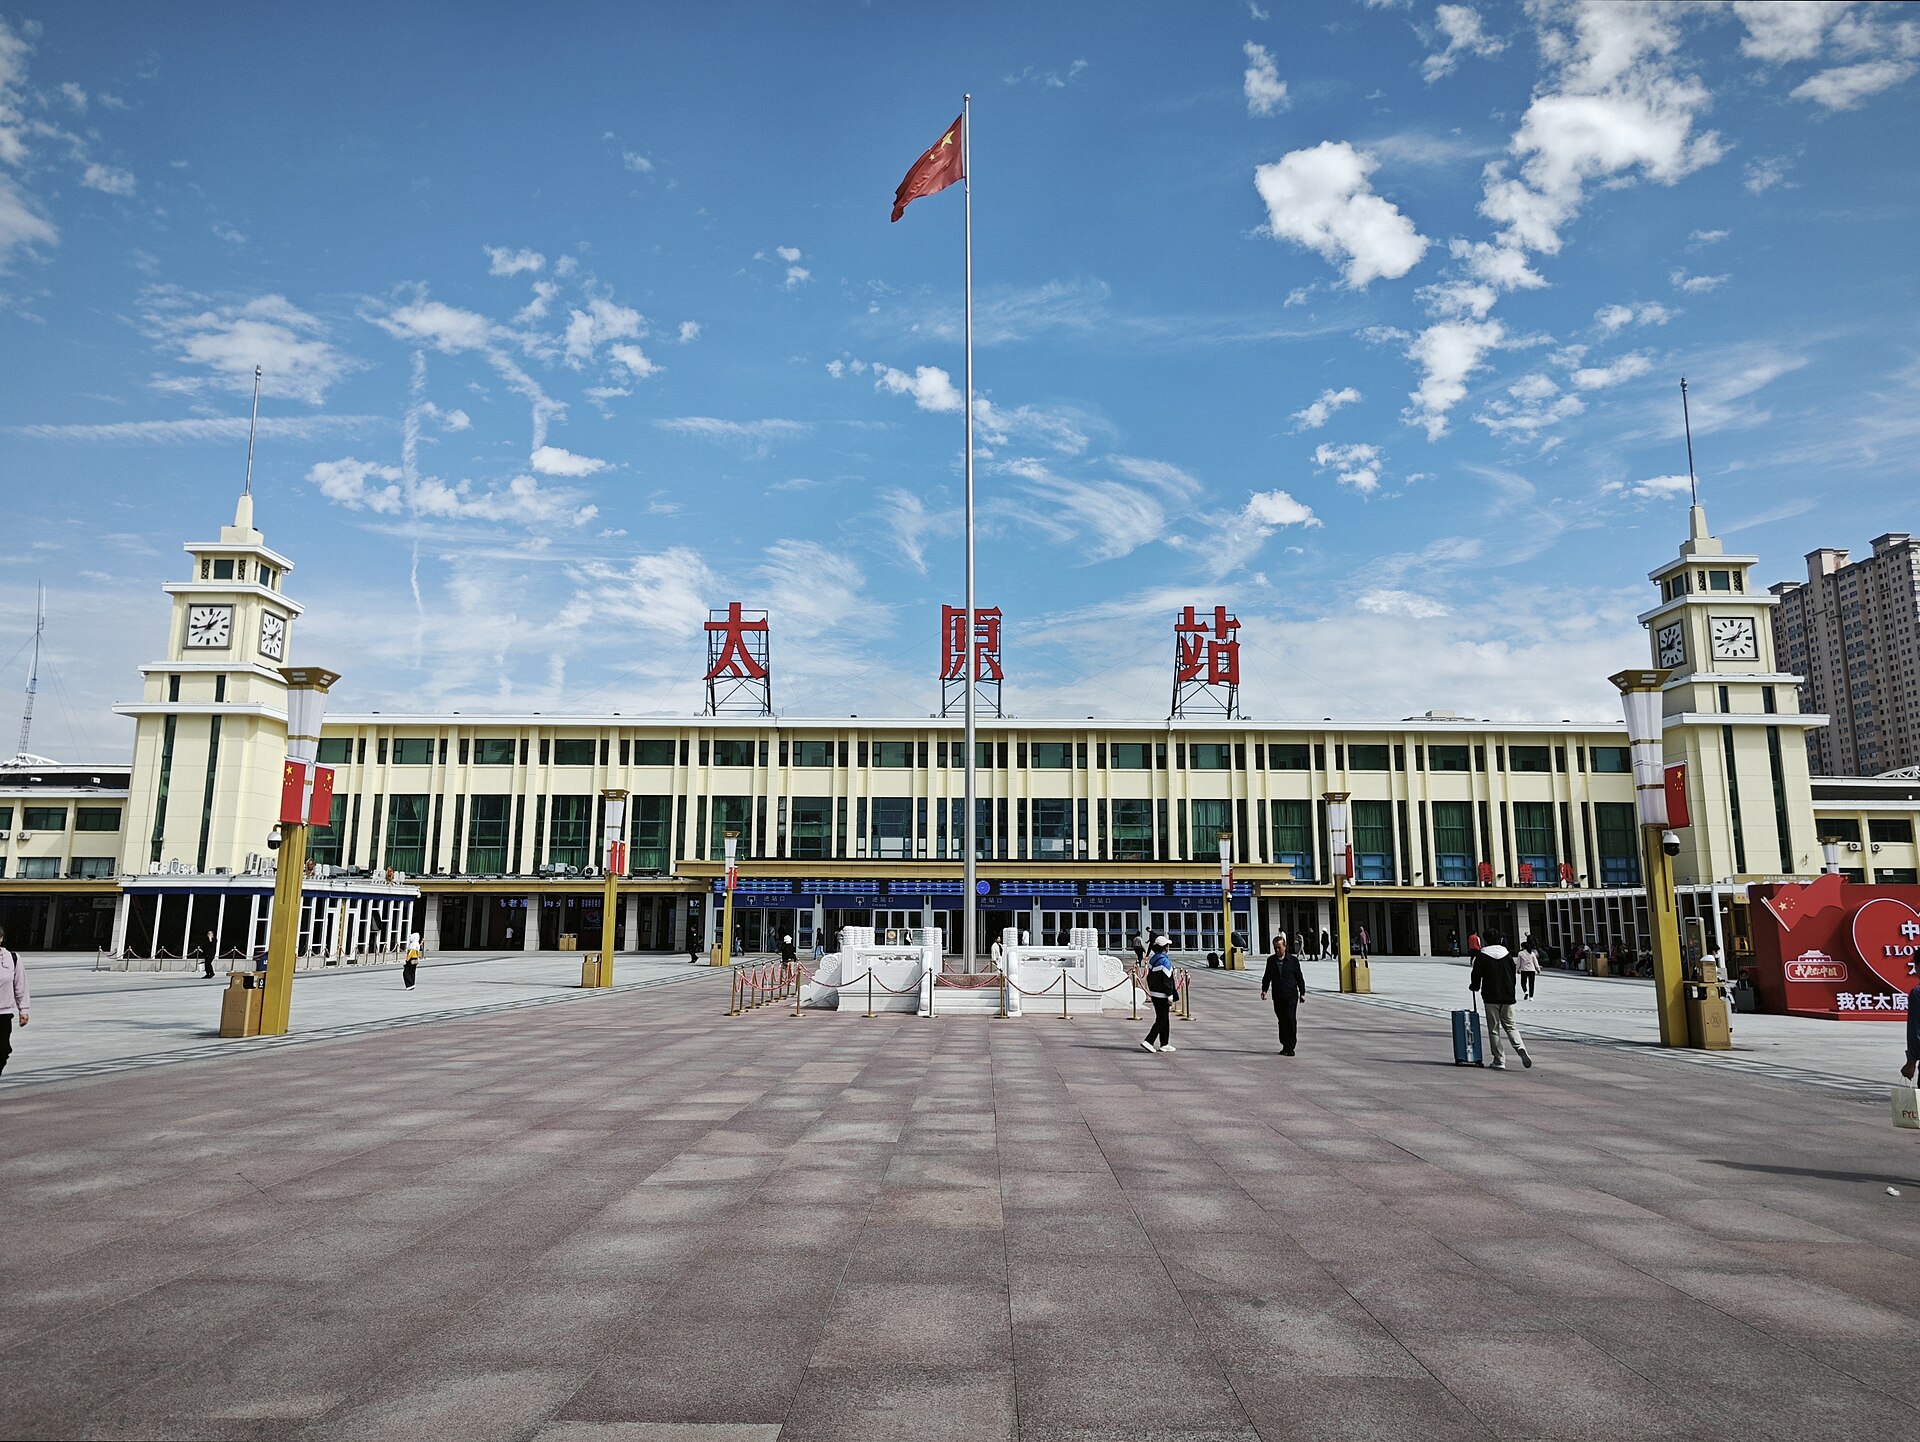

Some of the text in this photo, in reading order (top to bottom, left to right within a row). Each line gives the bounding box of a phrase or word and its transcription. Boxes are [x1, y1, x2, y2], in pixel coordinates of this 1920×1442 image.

[1479, 862, 1573, 883] 售票处
[1901, 920, 1920, 940] 中
[1884, 945, 1892, 956] I
[1836, 992, 1909, 1011] 我在太原
